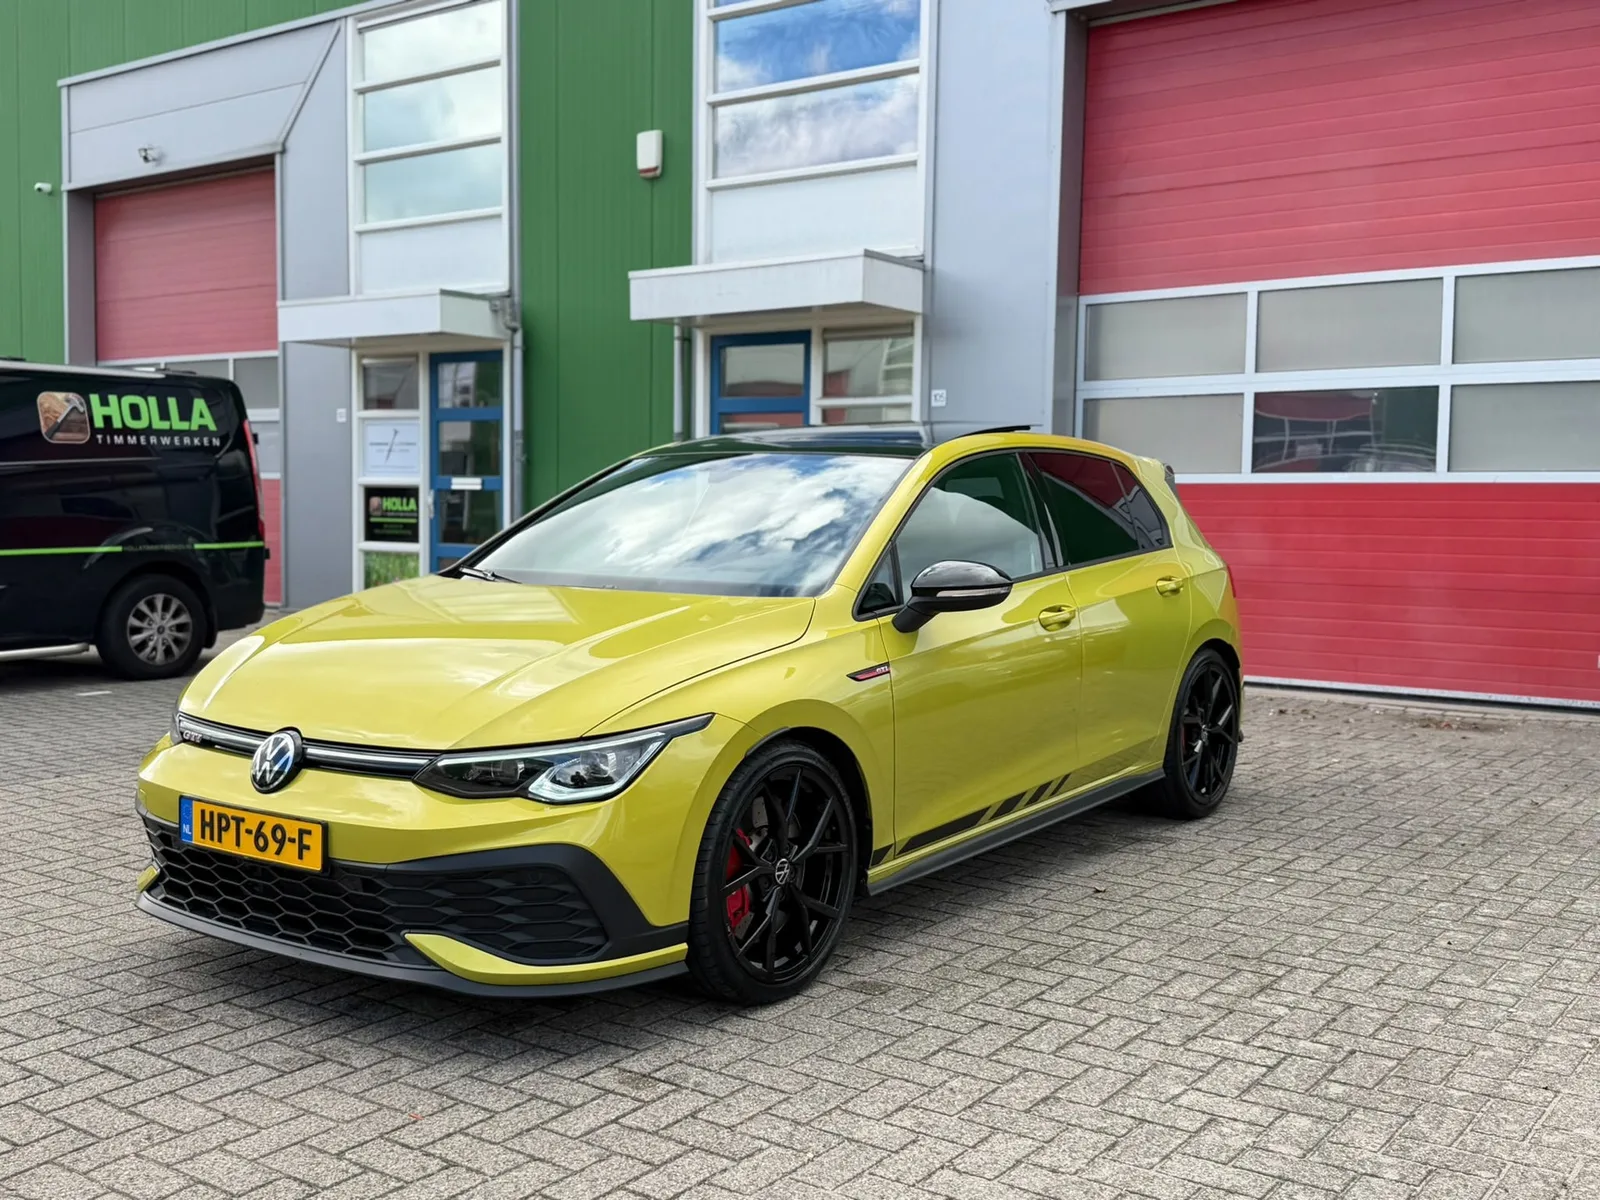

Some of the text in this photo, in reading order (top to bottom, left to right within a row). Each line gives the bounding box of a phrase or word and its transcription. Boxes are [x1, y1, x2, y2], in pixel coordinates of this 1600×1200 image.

[89, 394, 217, 431] HOLLA
[96, 434, 221, 446] TIMMERWERKEN
[382, 496, 417, 511] HOLLA
[183, 730, 202, 743] GTI
[183, 824, 191, 834] NL
[200, 809, 312, 860] HPT-69-F
